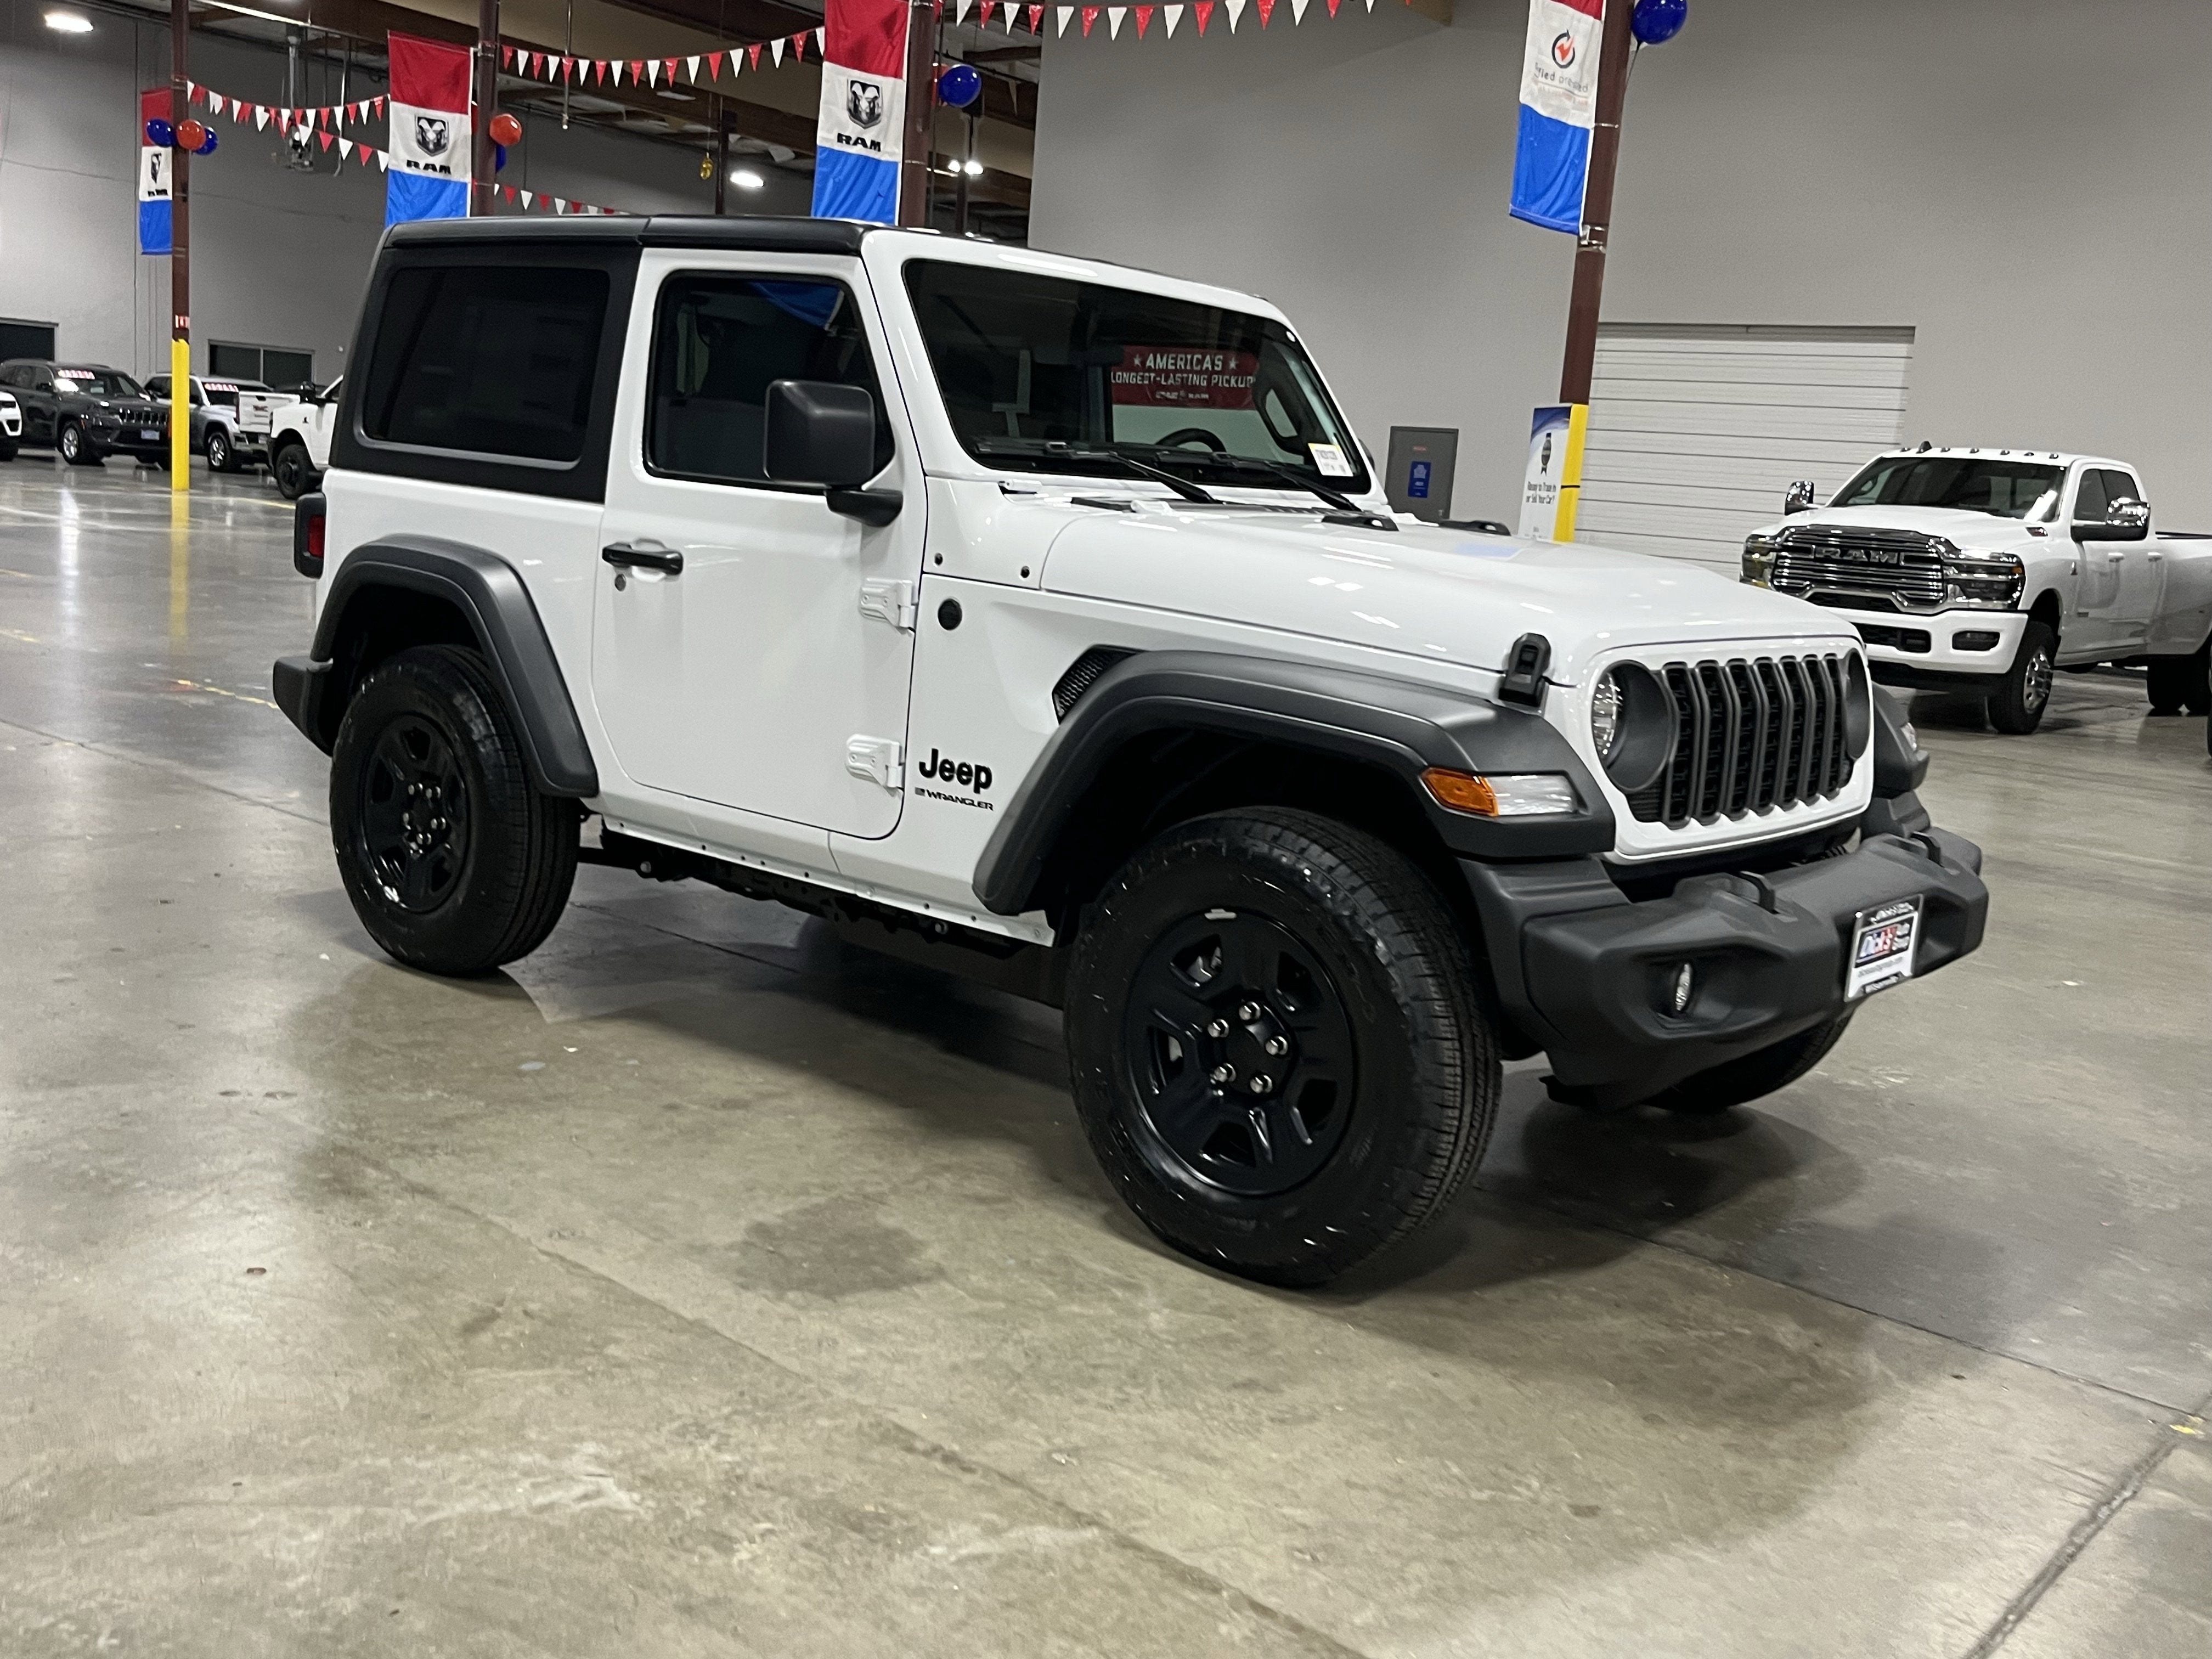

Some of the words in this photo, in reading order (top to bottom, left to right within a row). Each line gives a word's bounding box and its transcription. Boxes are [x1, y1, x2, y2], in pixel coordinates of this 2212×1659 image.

[837, 132, 881, 153] RAM
[406, 160, 452, 175] RAM
[1146, 353, 1223, 371] AMERICA'S
[1110, 371, 1207, 387] LONGEST-LASTING
[1211, 374, 1256, 388] PICKUP
[1815, 546, 1899, 564] RAM
[918, 748, 992, 795] Jeep
[926, 789, 994, 812] WRANGLER
